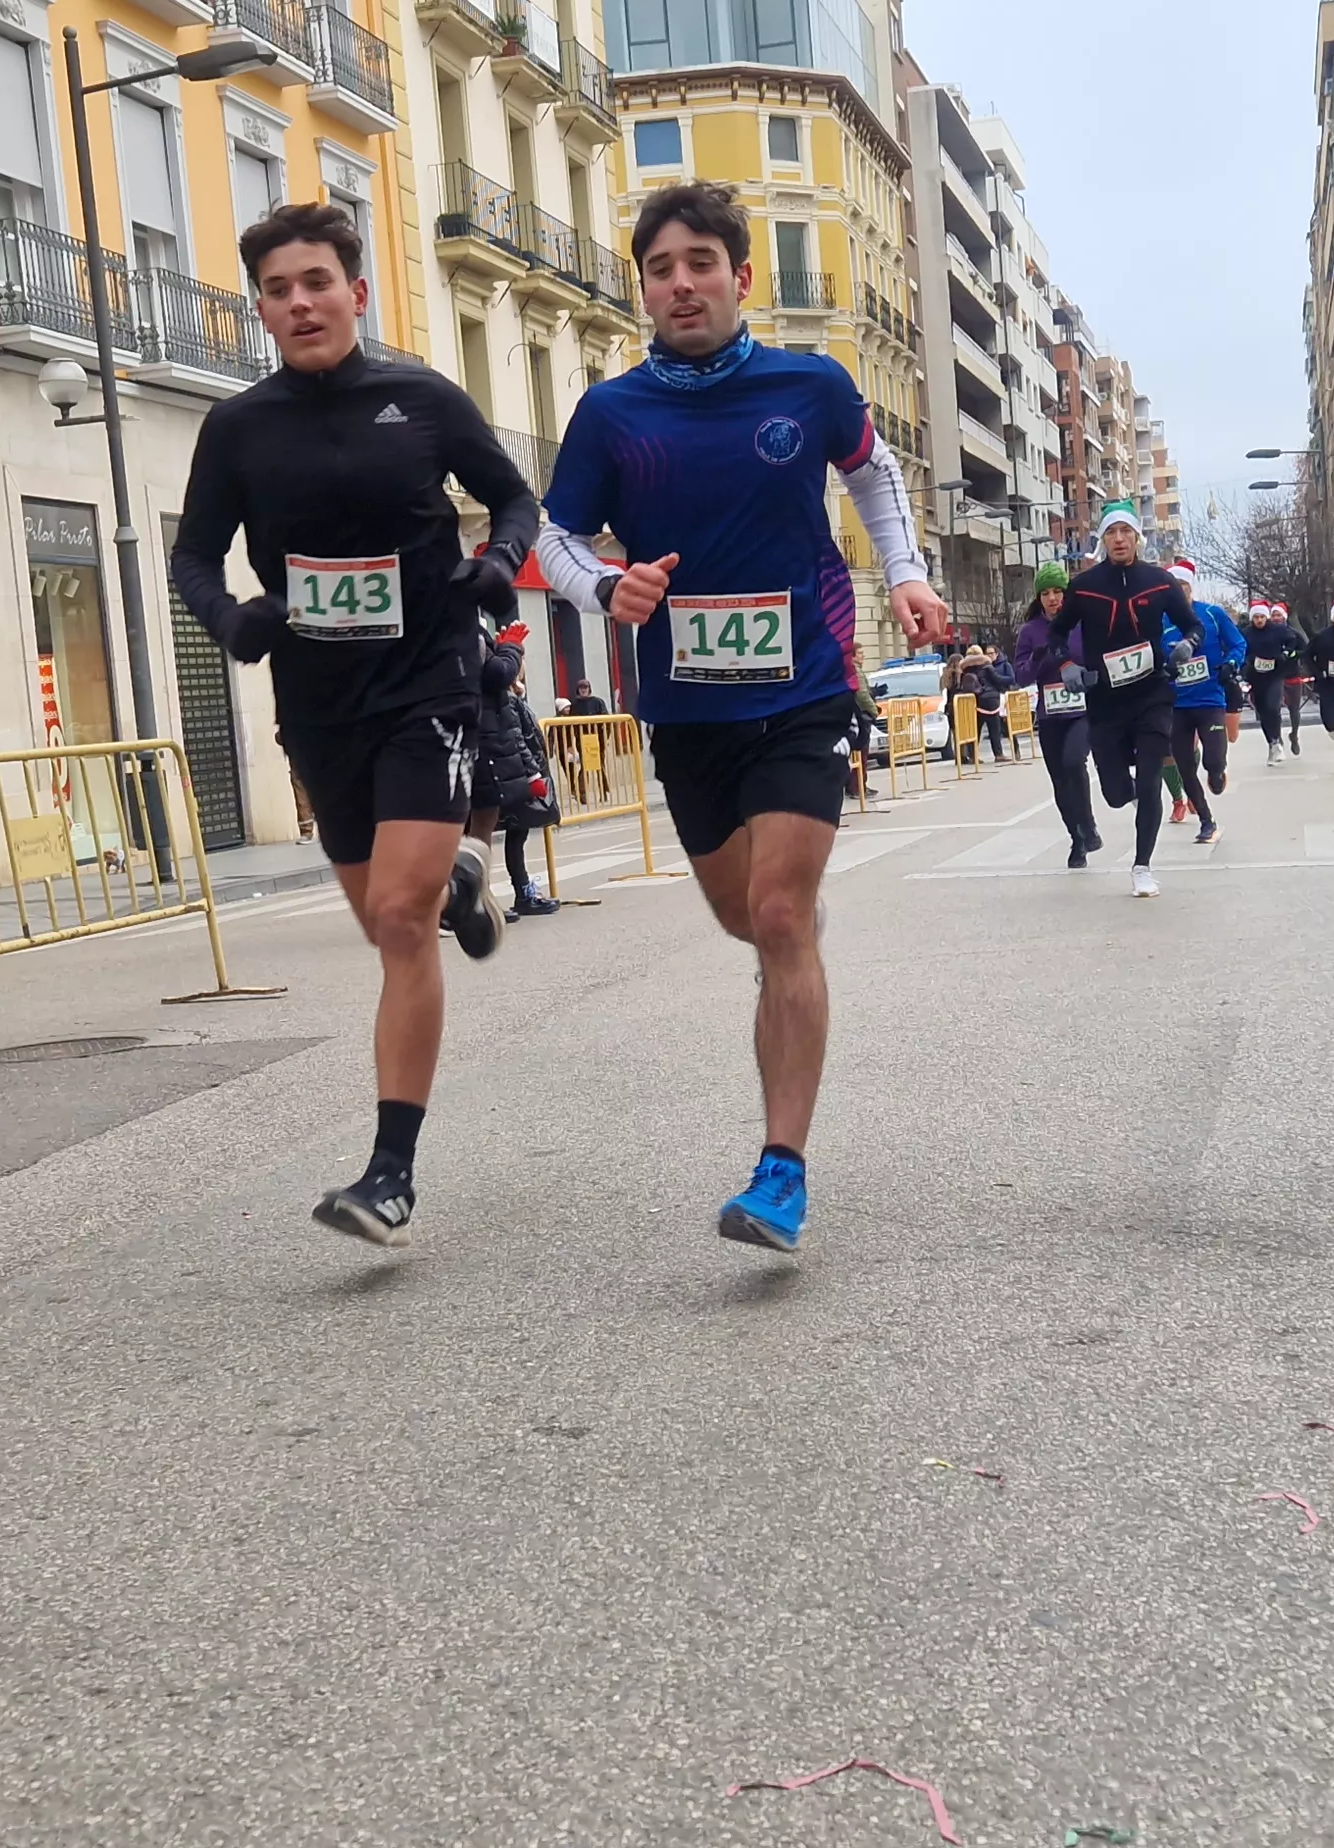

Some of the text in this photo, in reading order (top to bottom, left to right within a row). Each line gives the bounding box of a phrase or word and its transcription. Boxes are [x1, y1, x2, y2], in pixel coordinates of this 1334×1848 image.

[24, 516, 56, 544] Pilar
[303, 572, 392, 616] 143
[689, 610, 783, 657] 142
[1119, 651, 1143, 674] 17
[1177, 661, 1206, 679] 289
